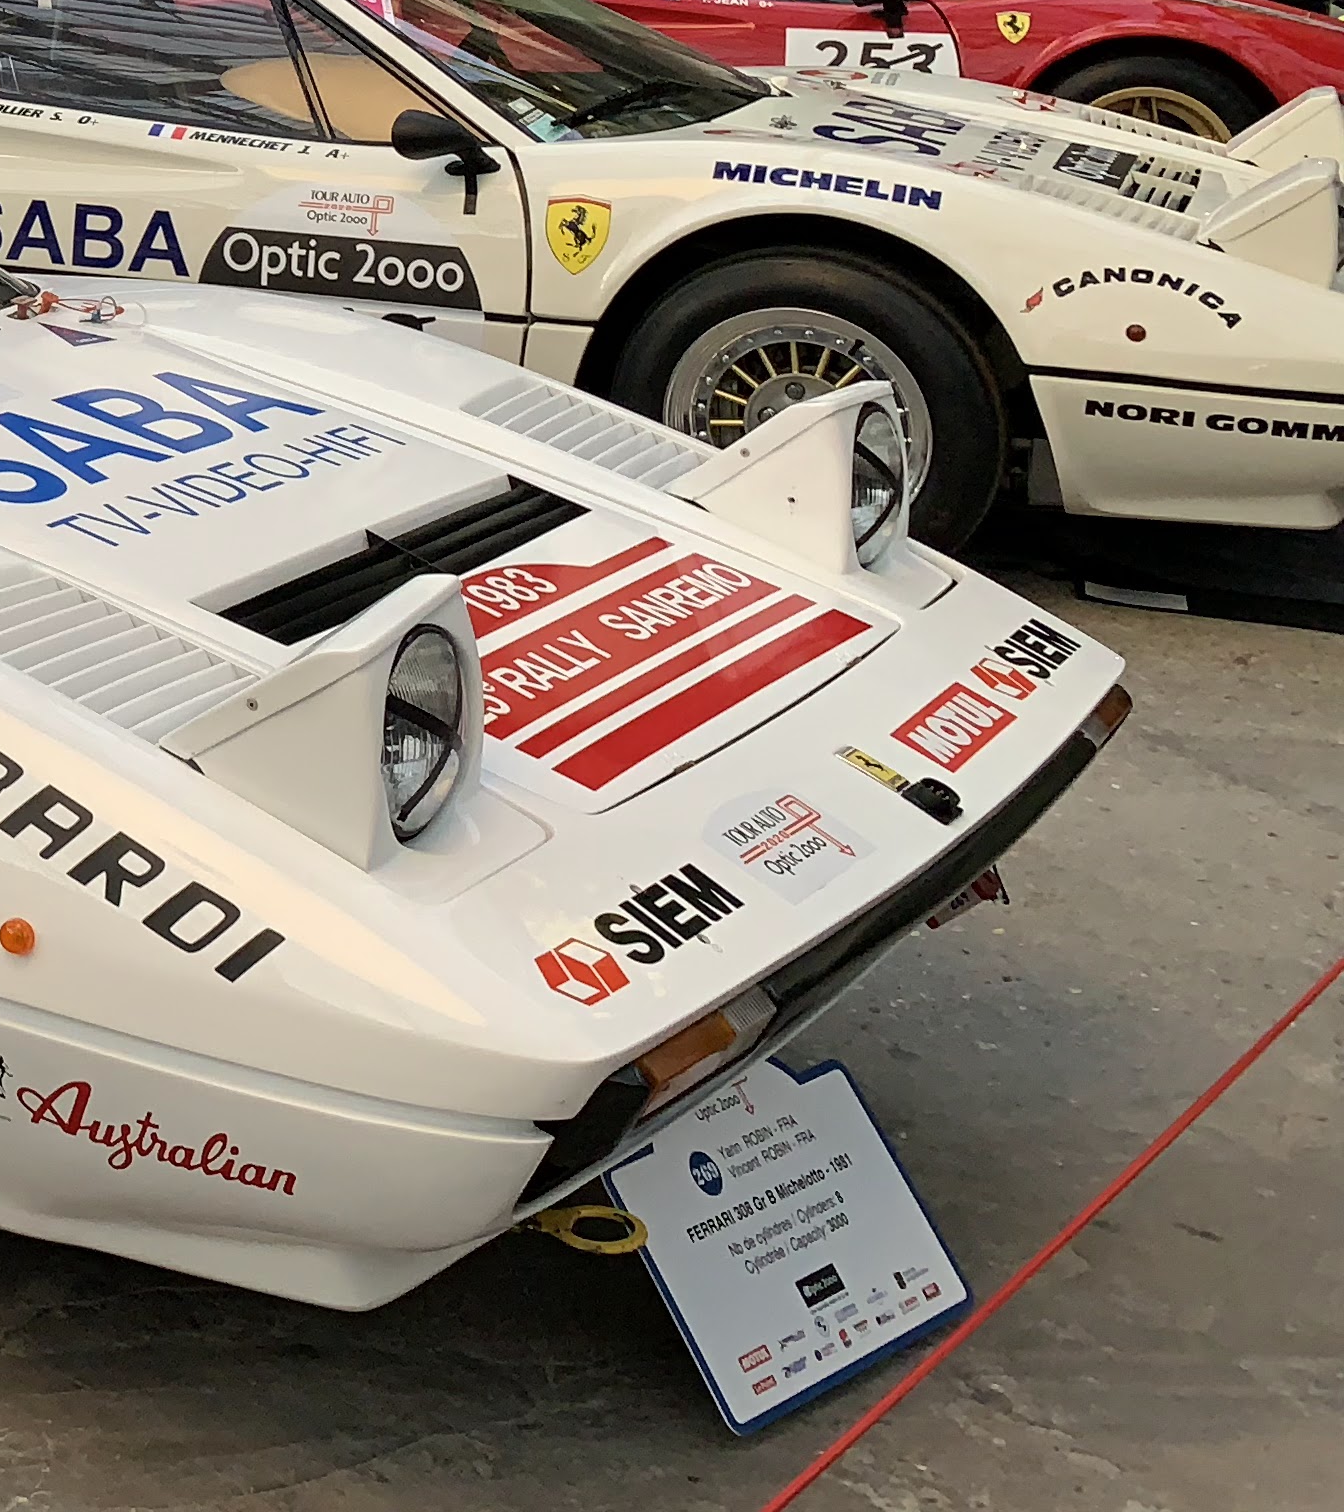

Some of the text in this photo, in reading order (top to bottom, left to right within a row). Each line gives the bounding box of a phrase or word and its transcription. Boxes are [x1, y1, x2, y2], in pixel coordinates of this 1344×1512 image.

[188, 130, 293, 153] MENNECHET
[311, 190, 370, 205] TOUR AUTO
[712, 161, 943, 210] MICHELIN
[306, 209, 368, 225] Optic 2000
[223, 232, 465, 292] Optic 2000
[1052, 266, 1243, 330] CANONICA
[1084, 399, 1195, 427] NORI
[46, 422, 408, 547] TV-VIDEO-HIFI
[463, 567, 558, 618] 1983
[487, 629, 612, 700] RALLY
[598, 562, 752, 640] SANREMO
[992, 618, 1083, 680] SIEM
[906, 691, 1005, 765] MOTUL
[721, 805, 787, 847] TOUR AUTO
[760, 830, 791, 851] 2020
[763, 836, 828, 876] Optic 2000
[593, 862, 746, 965] SIEM
[16, 1080, 299, 1196] Australian
[717, 1141, 743, 1161] Yann
[742, 1124, 774, 1149] ROBIN
[775, 1114, 799, 1134] FRA
[726, 1155, 763, 1179] Vincent
[761, 1140, 794, 1165] ROBIN
[794, 1128, 817, 1146] FRA
[691, 1161, 720, 1186] 269
[686, 1208, 736, 1243] FERRARI
[732, 1200, 755, 1222] 308
[752, 1195, 768, 1211] Gr
[765, 1189, 777, 1205] B
[774, 1168, 825, 1201] Michelotto
[755, 1217, 793, 1245] cylindres
[834, 1190, 845, 1204] 8
[826, 1211, 850, 1234] 3000
